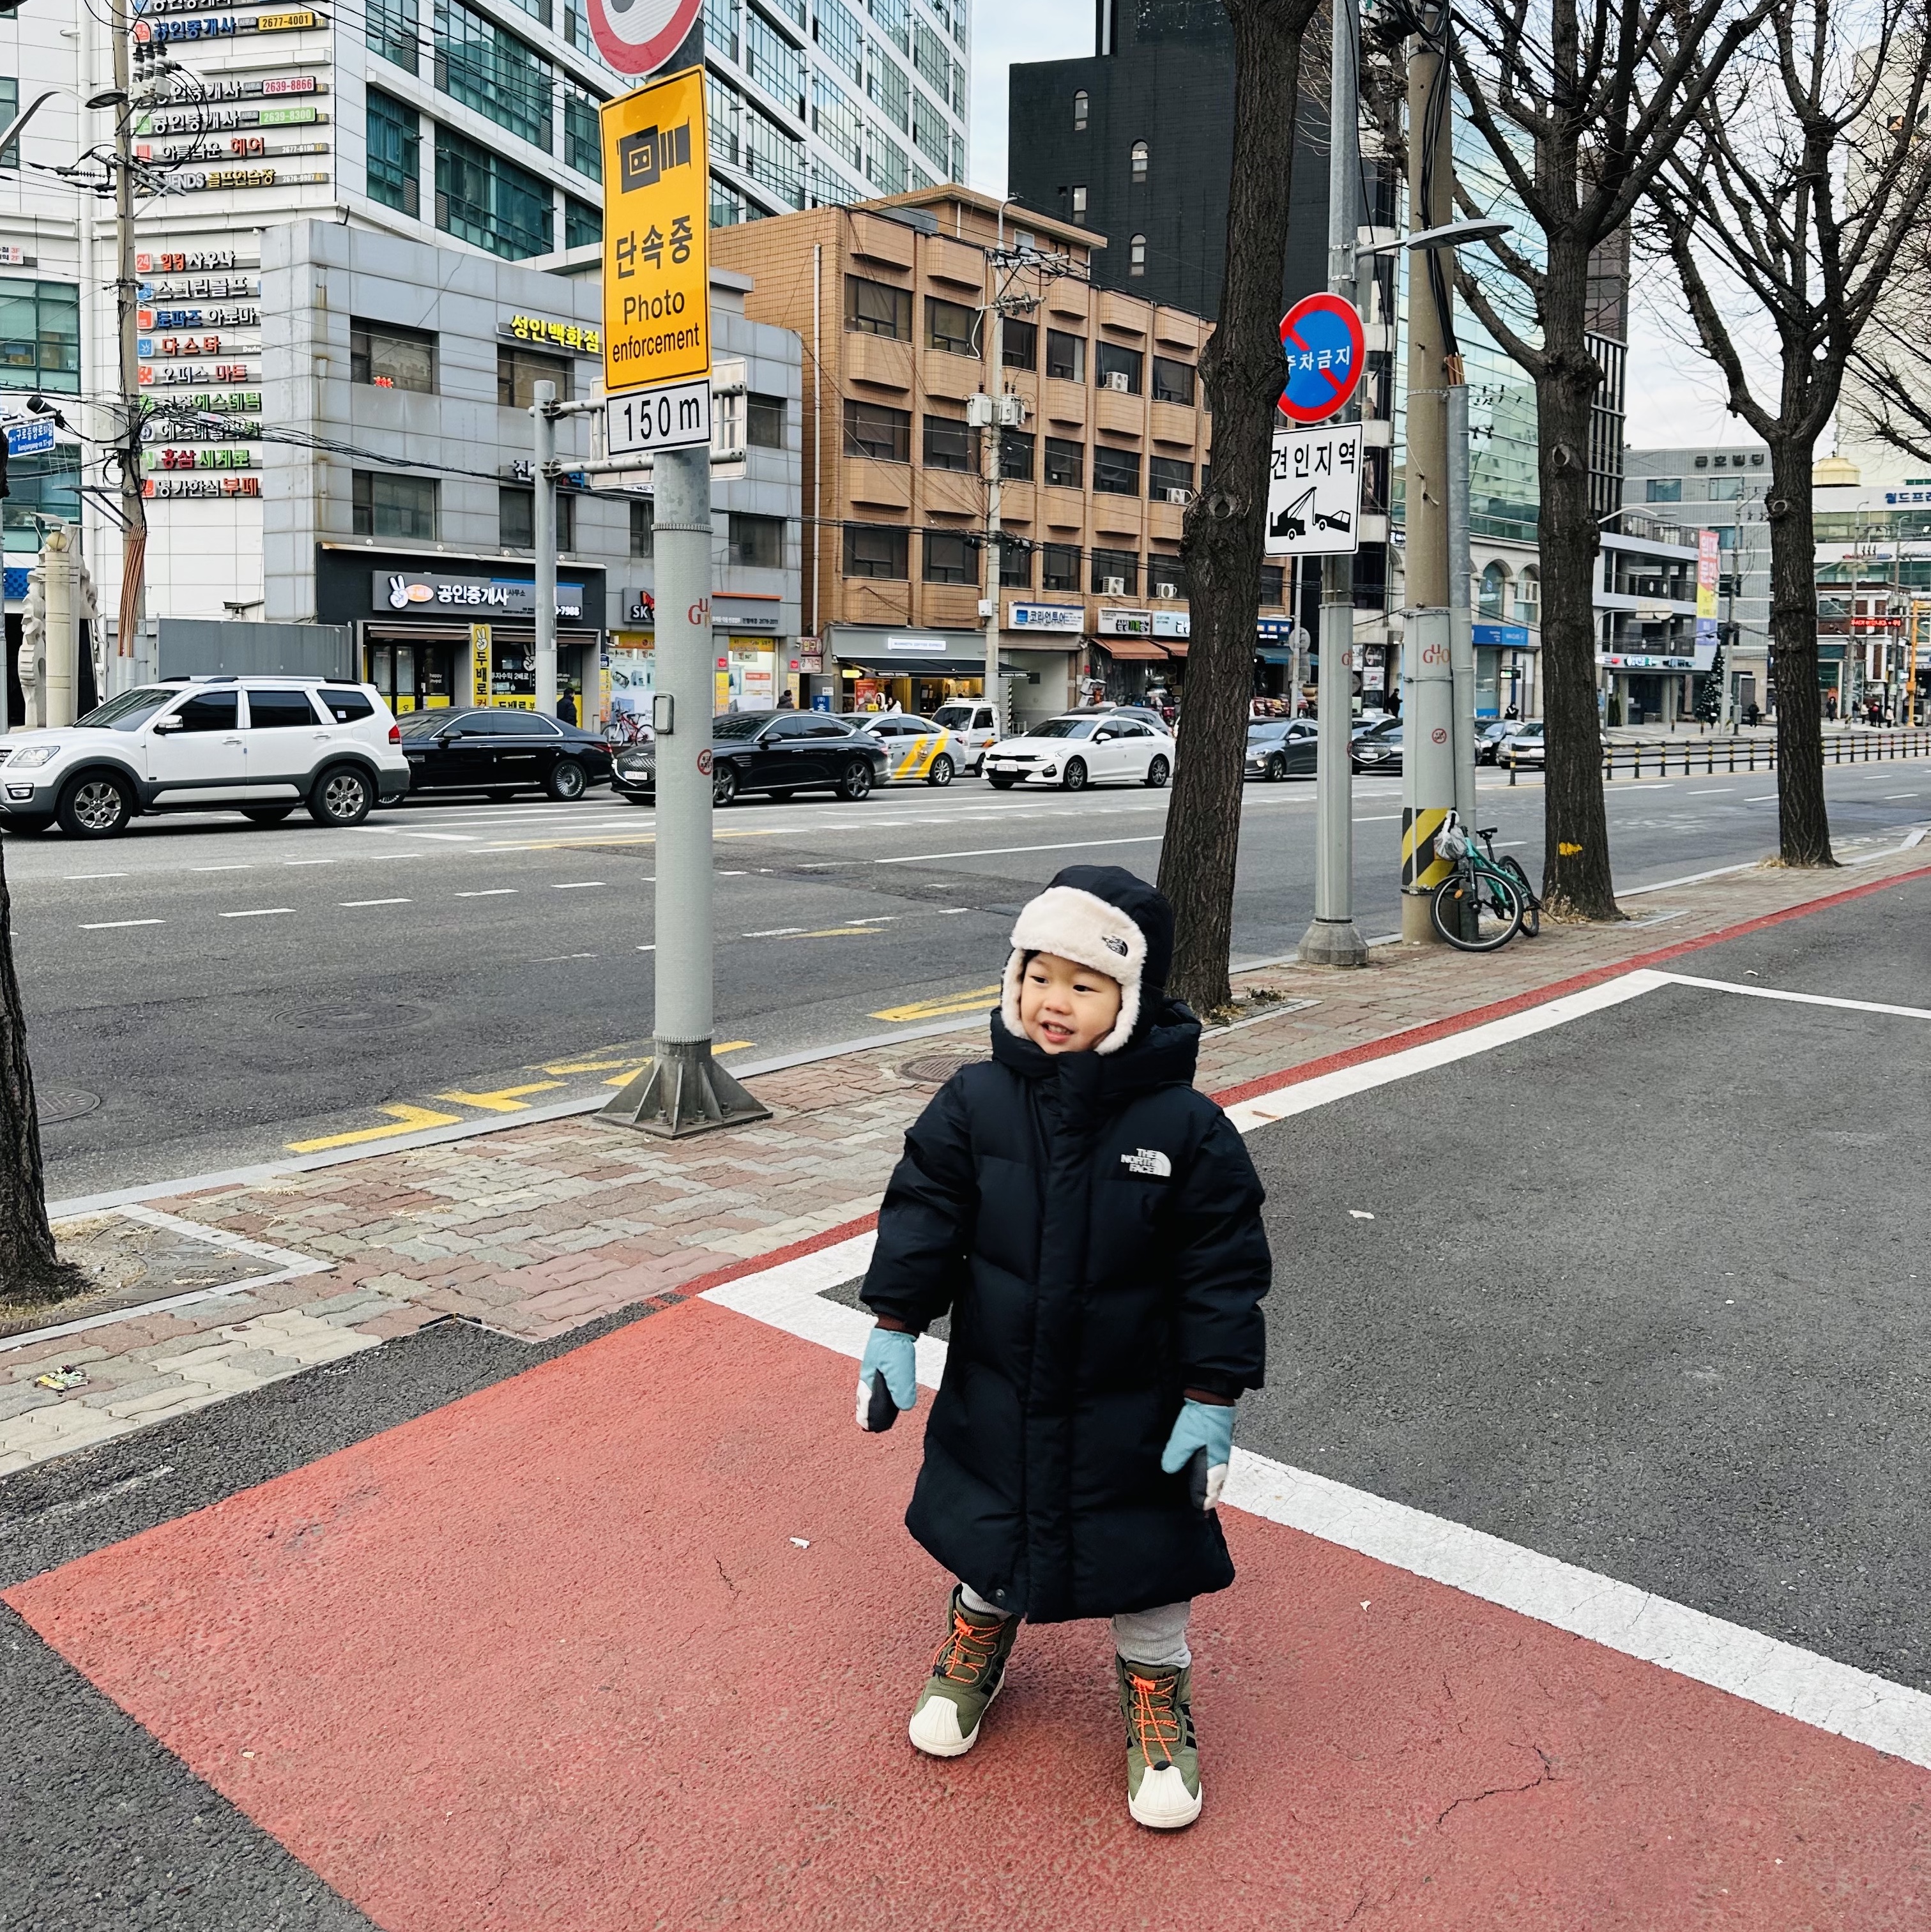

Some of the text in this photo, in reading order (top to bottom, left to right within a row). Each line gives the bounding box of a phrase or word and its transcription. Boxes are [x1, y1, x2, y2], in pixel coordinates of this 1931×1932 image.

[153, 17, 236, 41] 공인중개사
[263, 15, 308, 28] 2677-4001
[157, 80, 241, 104] 인중개사
[265, 79, 312, 93] 2639-8866
[154, 110, 239, 133] 공인중개사
[264, 109, 311, 123] 2639-8300
[231, 137, 264, 156] 헤어
[208, 169, 276, 188] 골프연습장
[616, 215, 692, 279] 단속중
[189, 250, 236, 269] 사우나
[155, 277, 248, 299] 스크린골프
[208, 306, 256, 326] 아로마
[623, 289, 685, 325] Photo
[511, 314, 599, 353] 성인백화점
[613, 323, 699, 362] enforcement
[160, 365, 248, 384] 오피스 마트
[162, 449, 250, 469] 홍삼 세계로
[1271, 439, 1356, 480] 견인지역
[1695, 453, 1764, 468] 금호빌딩
[438, 584, 508, 605] 공인중개사
[632, 605, 648, 618] SK
[475, 651, 488, 696] 두배로
[1120, 1153, 1157, 1168] NORTH
[1136, 1148, 1157, 1159] THE
[1129, 1163, 1155, 1175] FACE
